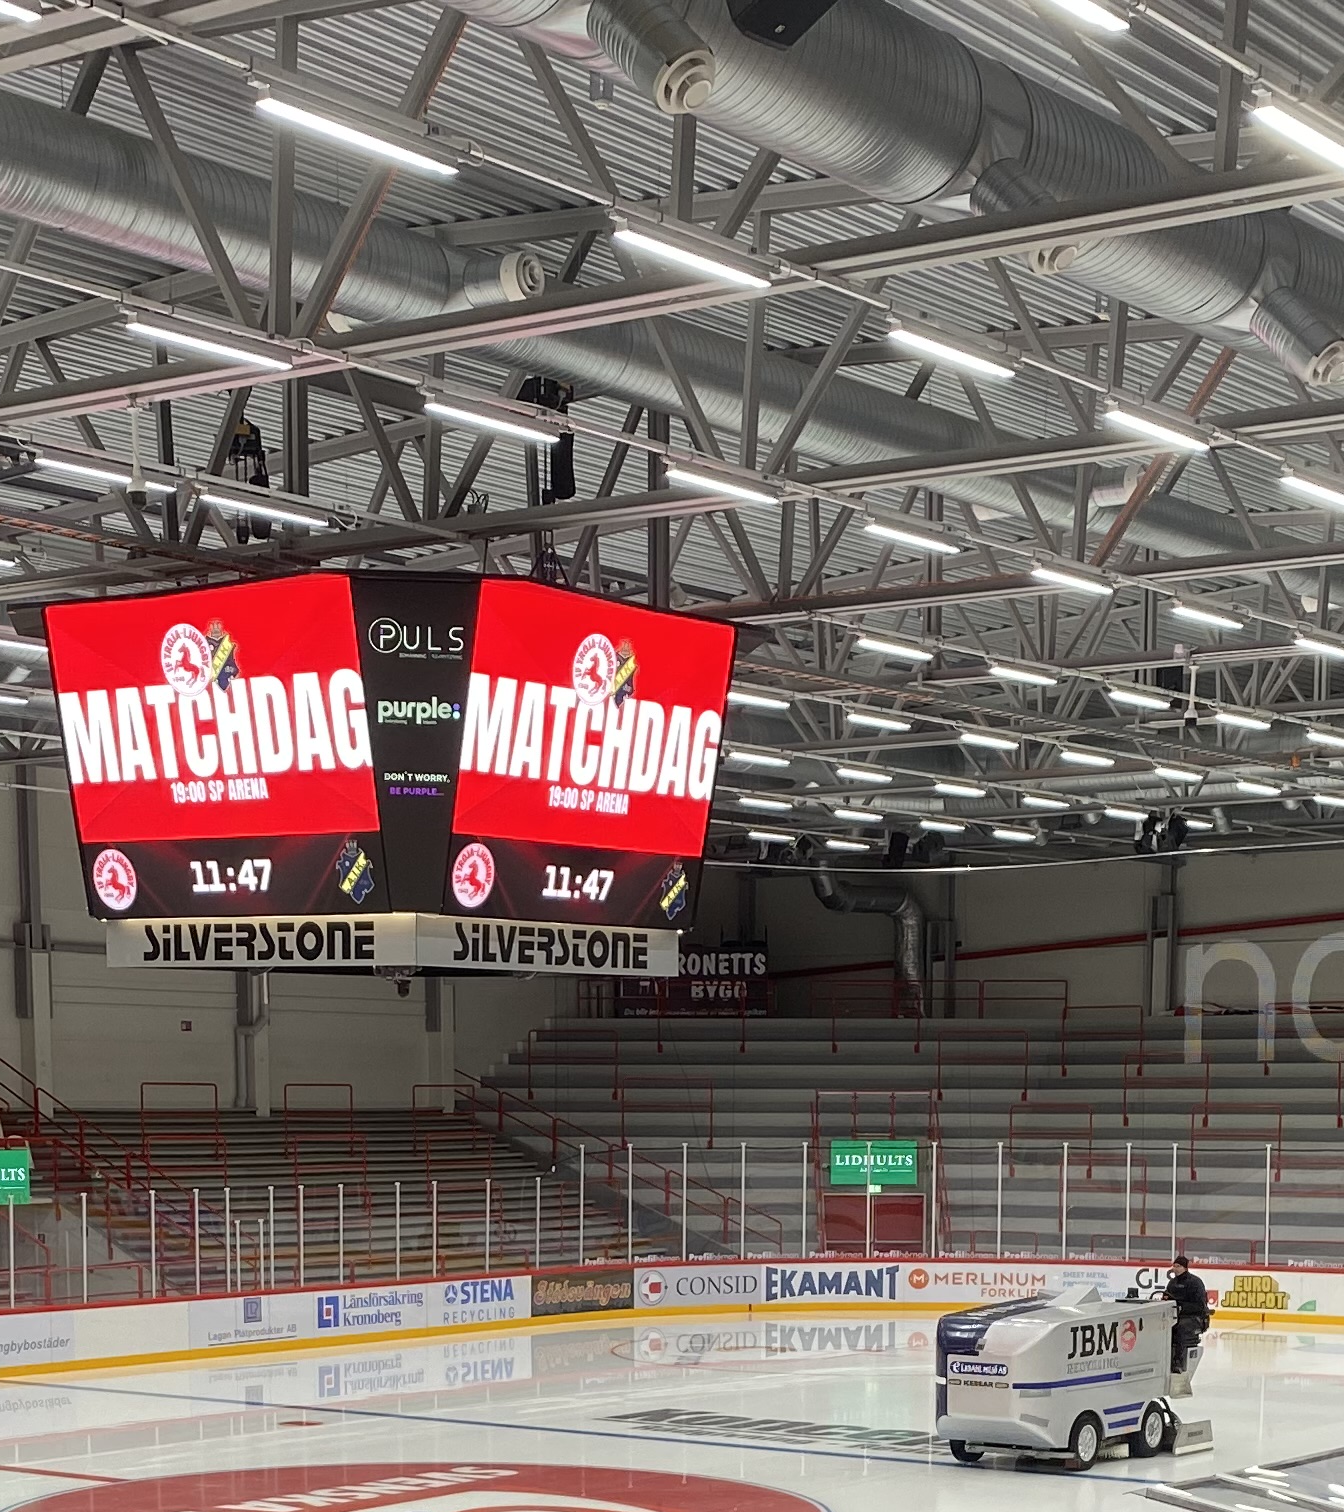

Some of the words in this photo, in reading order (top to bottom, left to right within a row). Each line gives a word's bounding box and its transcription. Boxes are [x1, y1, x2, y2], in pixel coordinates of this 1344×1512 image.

[371, 619, 464, 653] PULS
[58, 668, 373, 784] MATCHDAG
[459, 672, 722, 800] MATCHDAG
[384, 771, 413, 782] DON'T
[171, 781, 206, 804] 19:00
[208, 779, 225, 802] SP
[228, 778, 269, 801] ARENA
[549, 785, 578, 807] 19:00
[580, 788, 594, 811] SP
[596, 791, 629, 815] ARENA
[190, 858, 272, 893] 11:47
[542, 864, 614, 901] 11:47
[836, 1154, 913, 1166] LIDHULTS
[460, 1279, 514, 1305] STENA
[676, 1274, 757, 1296] CONSID
[765, 1264, 900, 1301] EKAMANT
[934, 1272, 1047, 1287] MERLINUM
[1234, 1276, 1272, 1292] EURO
[343, 1291, 424, 1310] Länsförsäkring
[1221, 1291, 1287, 1310] JACKPOT
[287, 1323, 297, 1333] AB
[343, 1310, 402, 1328] Kronoberg
[443, 1306, 515, 1324] RECYCLING
[1067, 1321, 1119, 1360] JBM
[226, 1466, 520, 1512] SVENSKA
